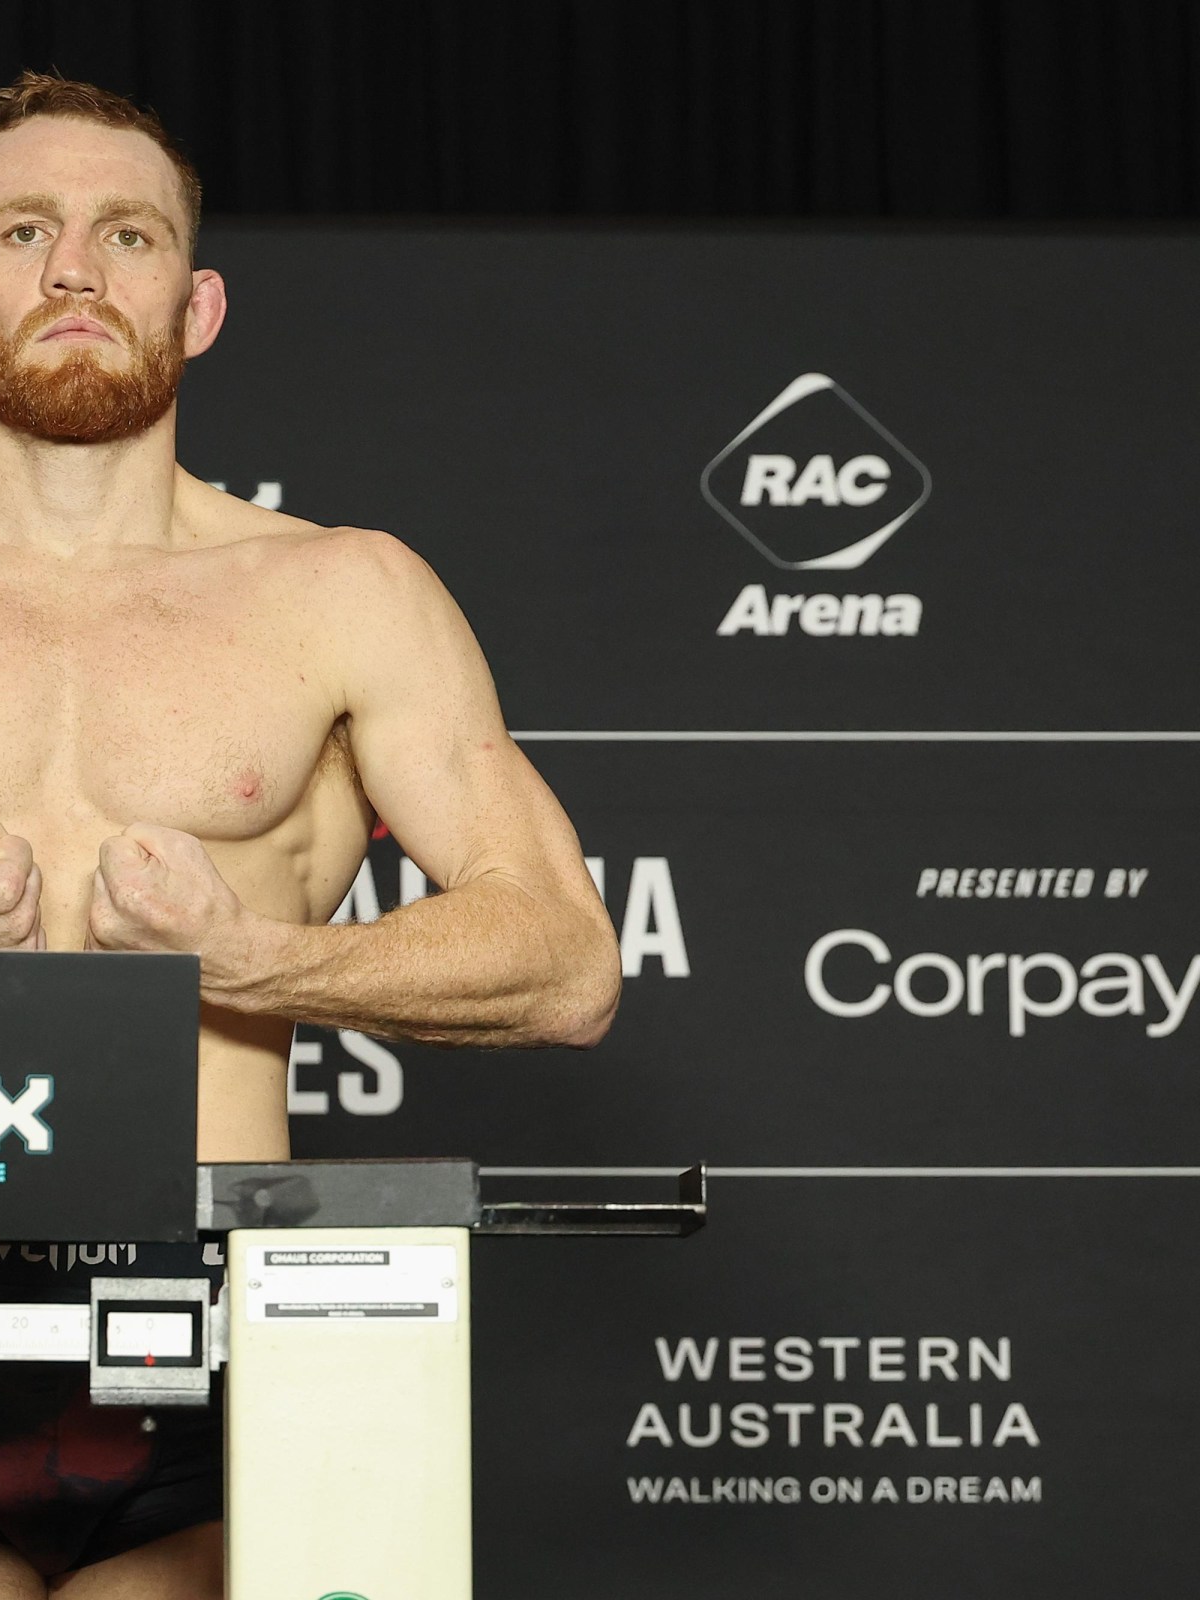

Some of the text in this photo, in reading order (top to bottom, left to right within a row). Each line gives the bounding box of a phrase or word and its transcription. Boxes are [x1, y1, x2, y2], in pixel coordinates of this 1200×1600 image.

[740, 454, 892, 507] RAC
[716, 583, 923, 637] Arena
[916, 867, 1149, 898] PRESENTED BY
[804, 929, 1200, 1038] Corpay
[309, 1253, 385, 1264] CORPORATION
[12, 1316, 29, 1329] 20
[655, 1337, 1011, 1381] WESTERN
[626, 1403, 1040, 1447] AUSTRALIA
[627, 1476, 1042, 1504] WALKING ON A DREAM
